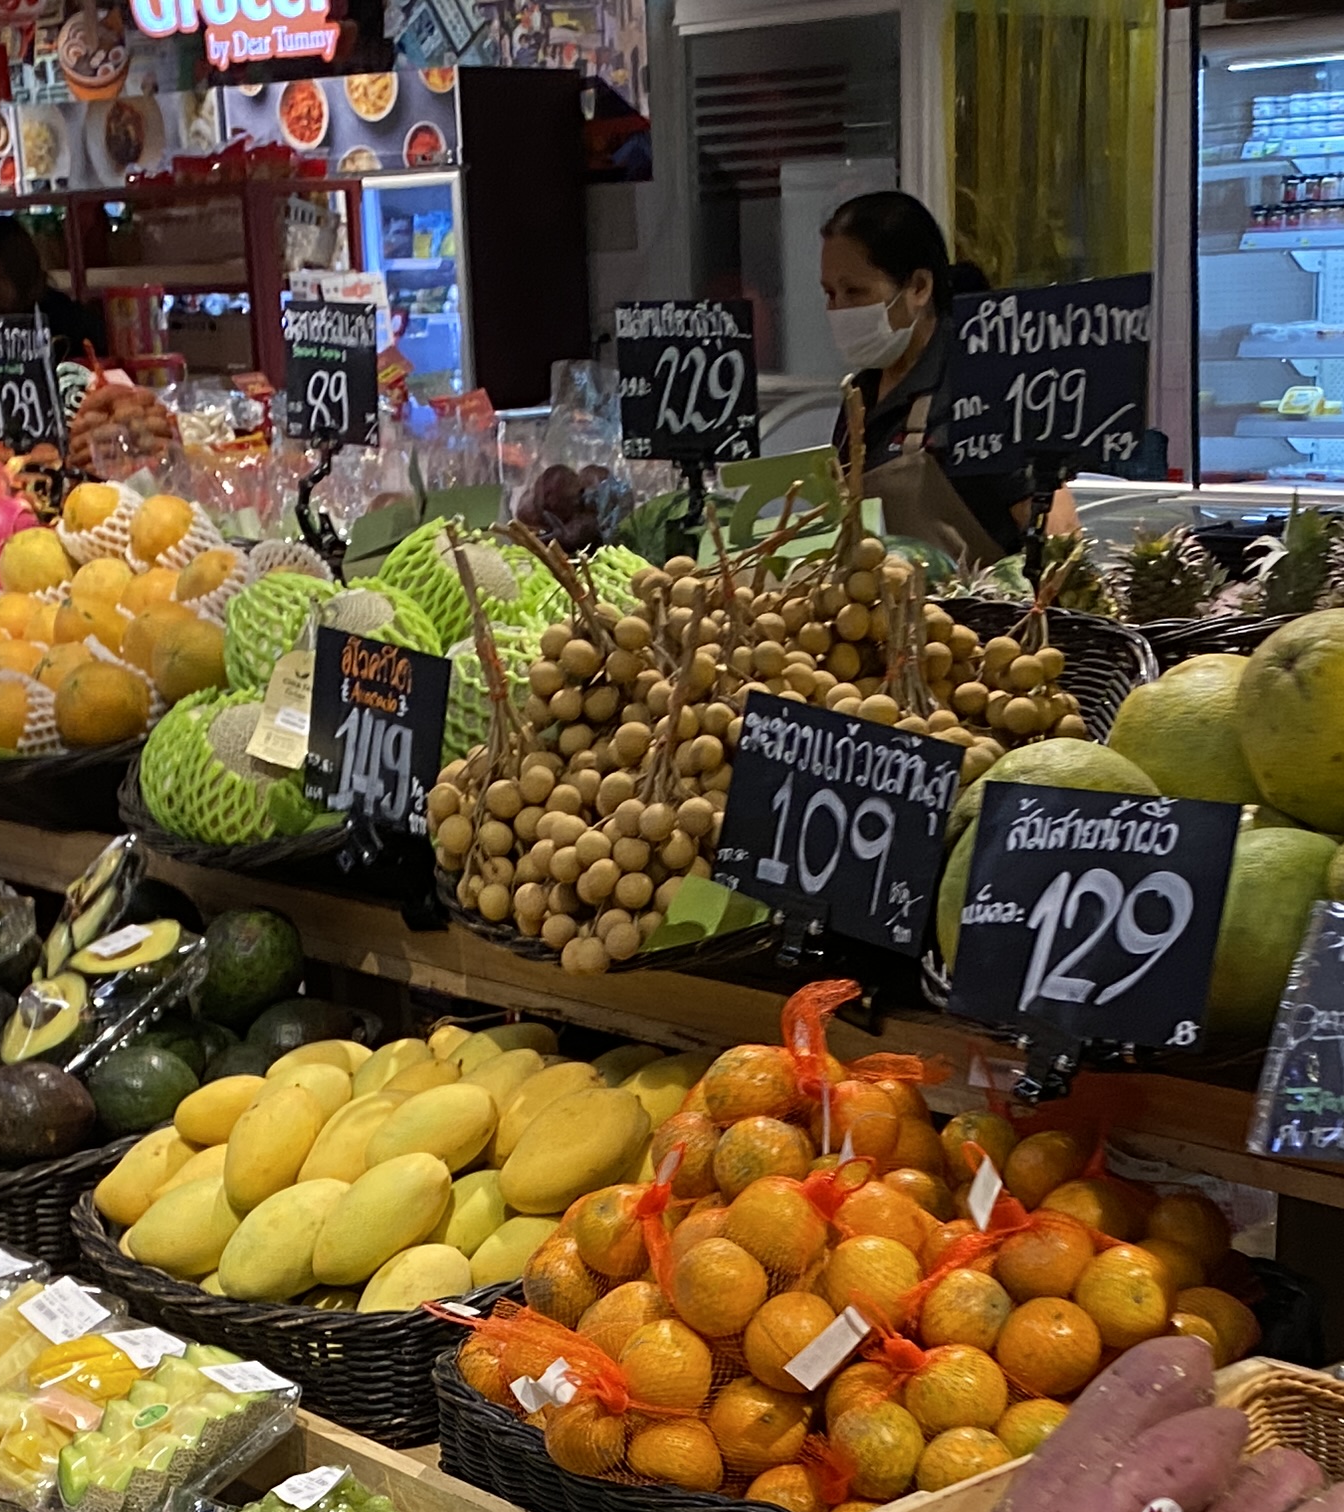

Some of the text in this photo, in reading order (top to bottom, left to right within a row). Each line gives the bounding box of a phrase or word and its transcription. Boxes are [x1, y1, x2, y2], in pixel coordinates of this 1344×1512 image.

[208, 26, 335, 65] by Dear Tummy
[306, 369, 349, 434] 89
[654, 345, 746, 434] 229
[1004, 367, 1087, 444] 199
[327, 706, 414, 823] 149
[756, 771, 897, 917] 109
[1018, 867, 1195, 1013] 129
